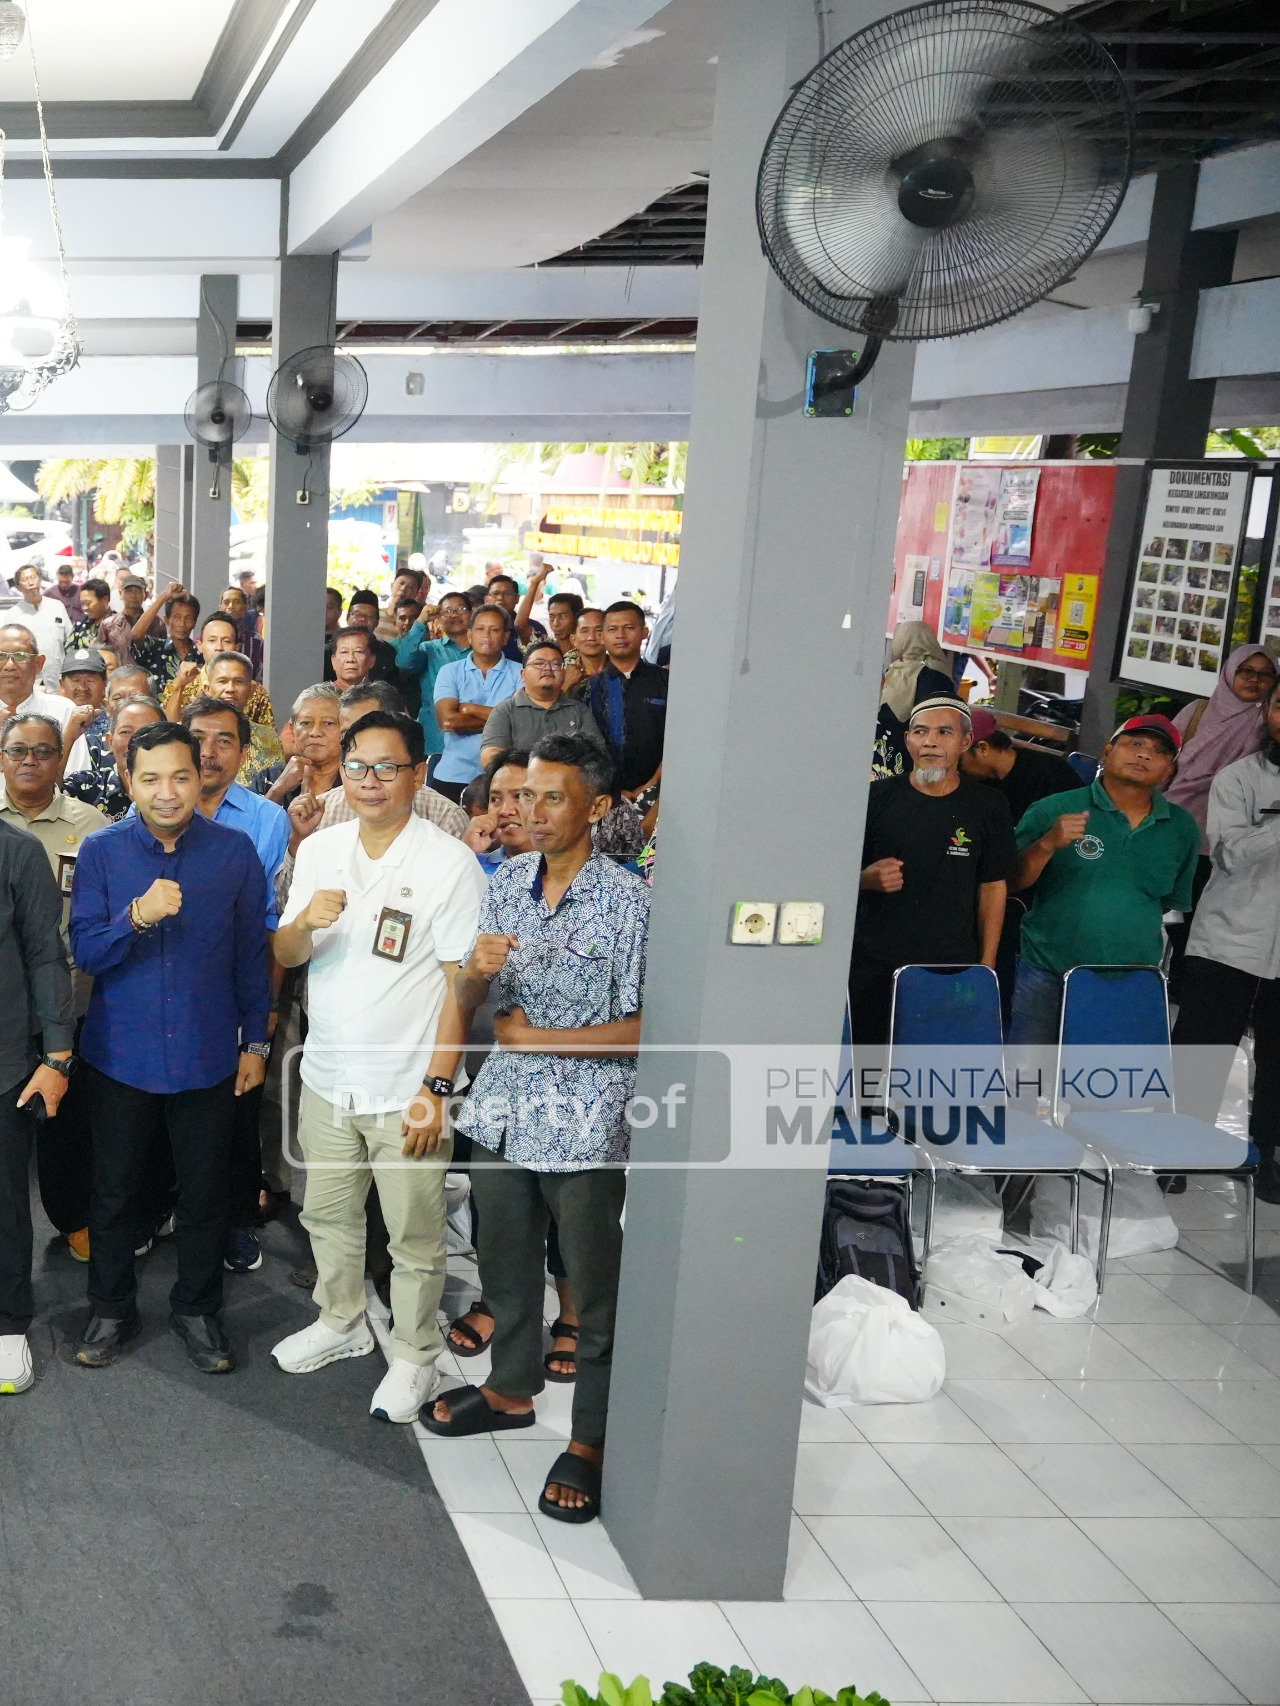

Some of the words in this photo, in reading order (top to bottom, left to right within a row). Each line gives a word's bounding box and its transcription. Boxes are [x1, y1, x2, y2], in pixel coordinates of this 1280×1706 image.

[1169, 470, 1232, 487] DOKUMENTASI
[1167, 489, 1194, 499] KEGIATAN
[1194, 490, 1229, 501] LINGKUNGAN
